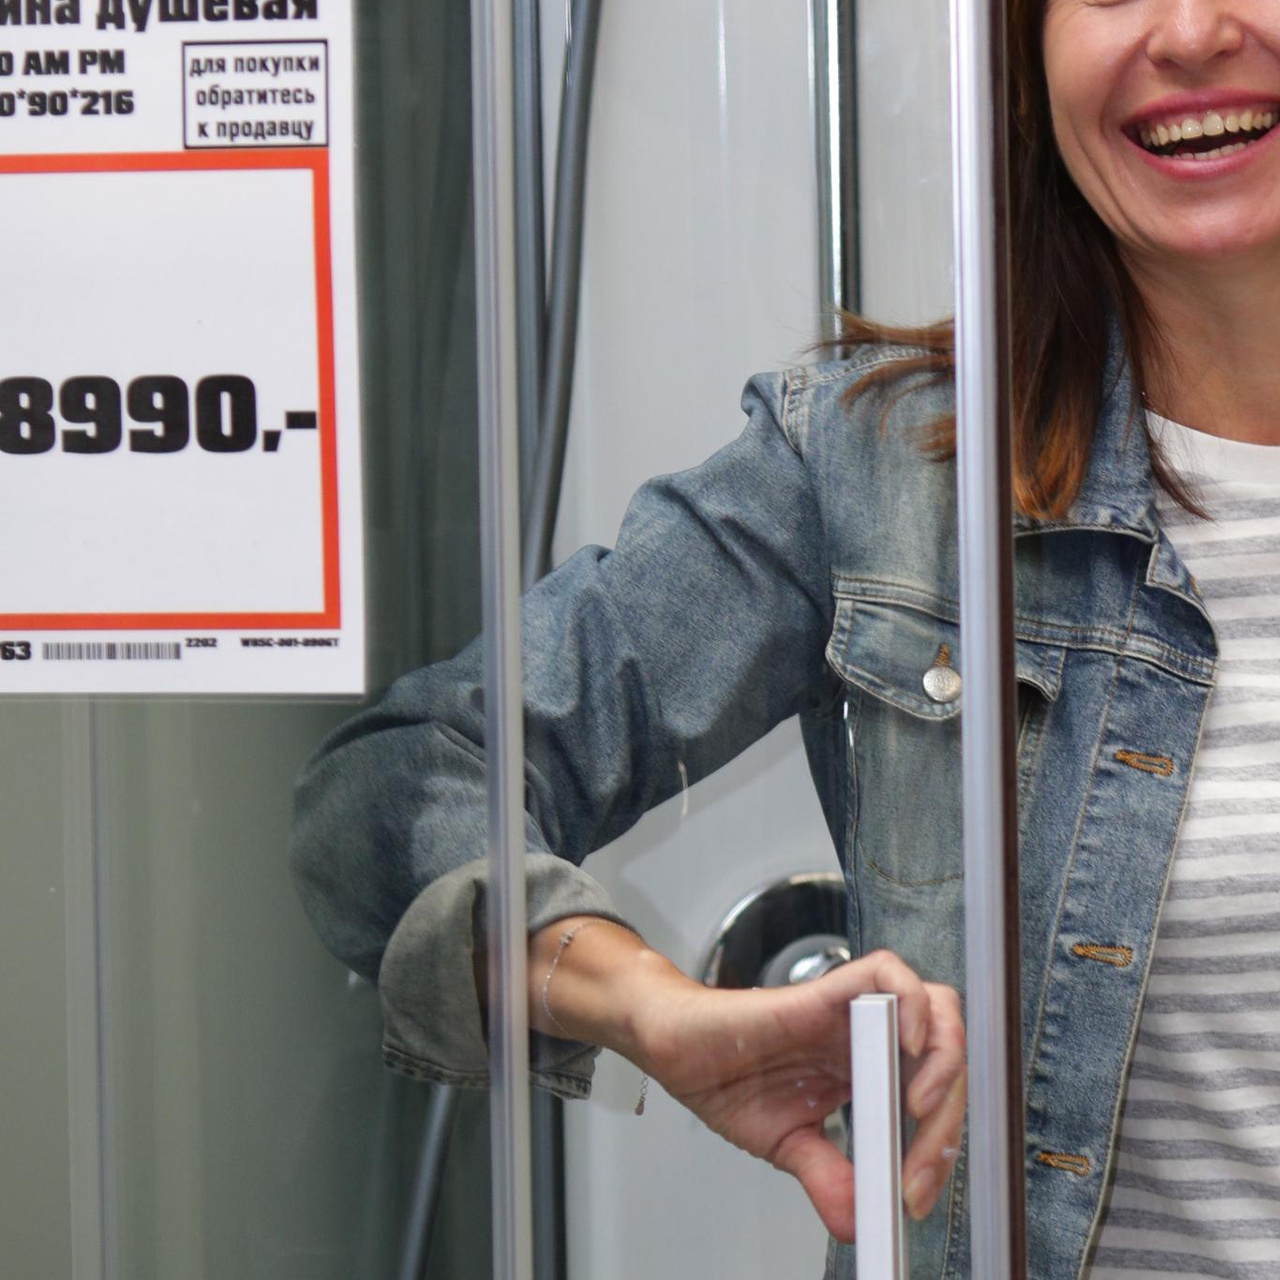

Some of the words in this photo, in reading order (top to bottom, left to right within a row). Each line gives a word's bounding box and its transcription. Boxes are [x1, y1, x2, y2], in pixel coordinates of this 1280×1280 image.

[22, 50, 70, 76] AM
[78, 50, 126, 75] PM
[189, 58, 226, 77] для
[234, 55, 320, 77] покупки
[196, 84, 316, 110] обратитесь
[198, 122, 209, 138] к
[217, 120, 314, 142] продавцу
